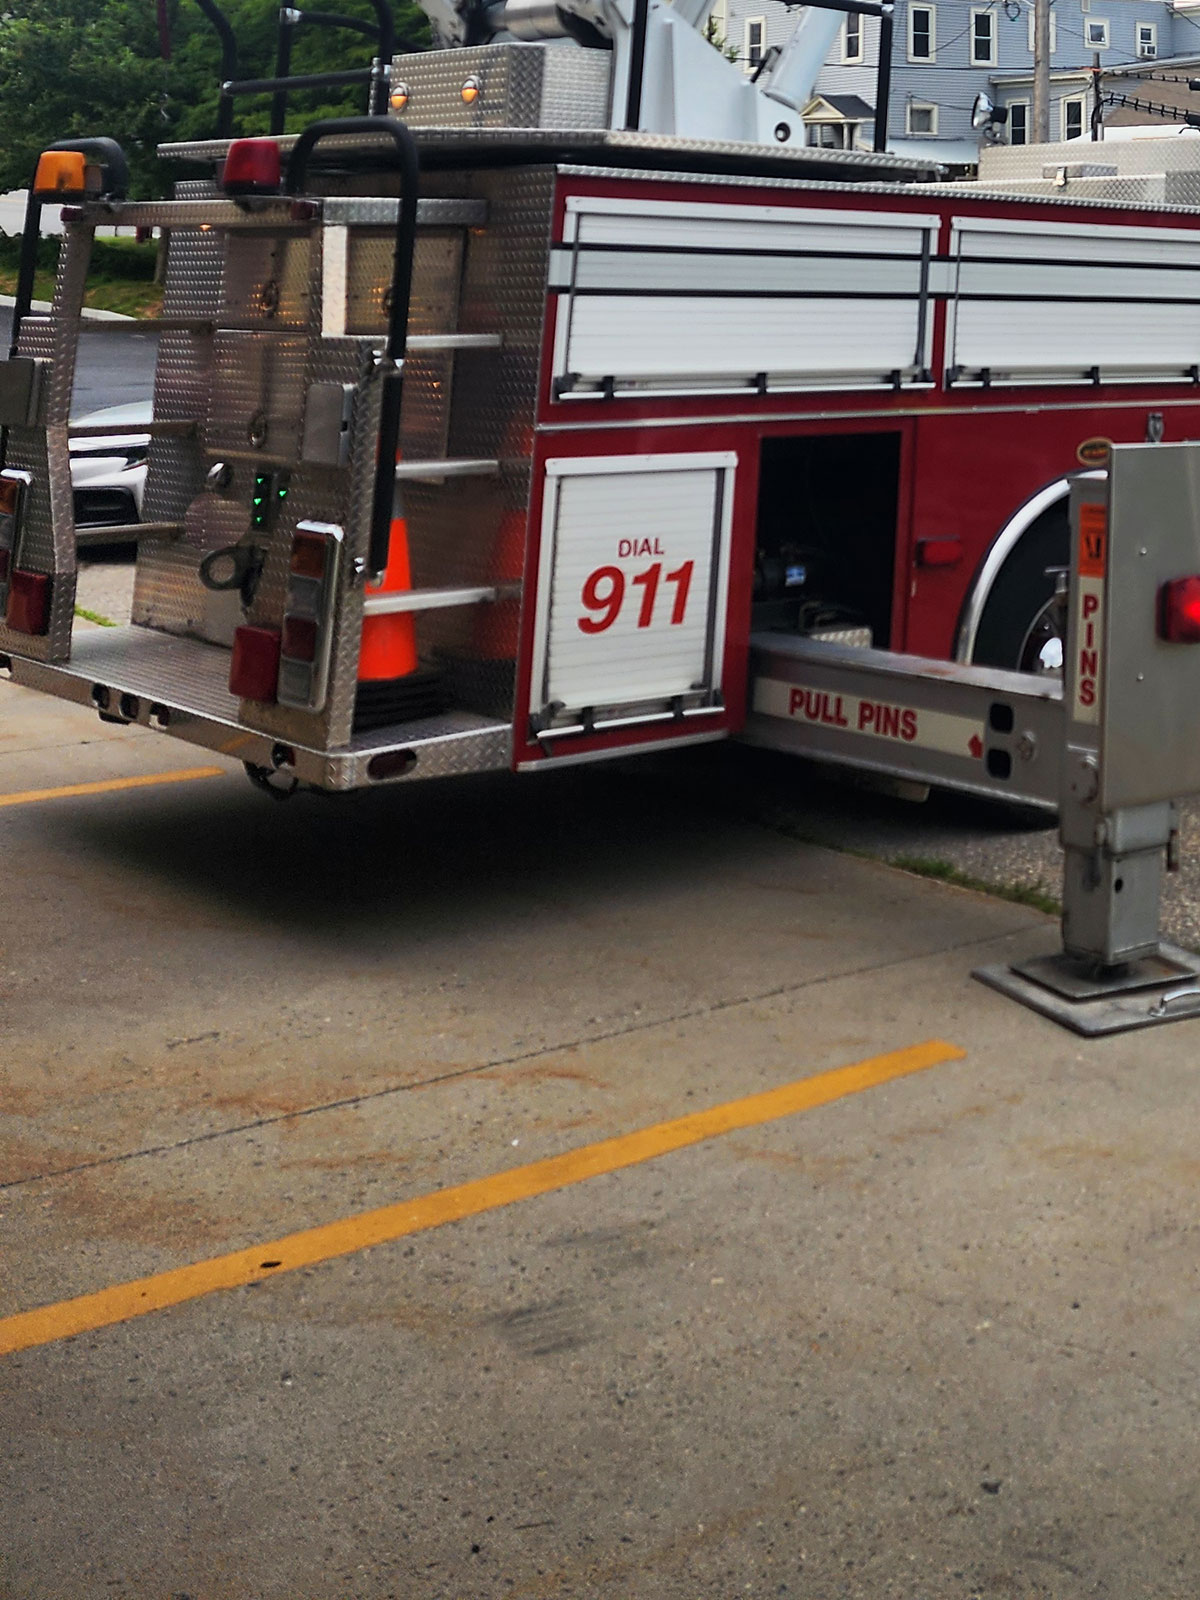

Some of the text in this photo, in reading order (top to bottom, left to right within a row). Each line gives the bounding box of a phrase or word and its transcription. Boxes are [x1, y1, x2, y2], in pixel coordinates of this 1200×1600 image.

[617, 538, 666, 558] DIAL
[577, 560, 695, 635] 911
[1079, 594, 1099, 706] PINS
[788, 687, 918, 742] PULL PINS
